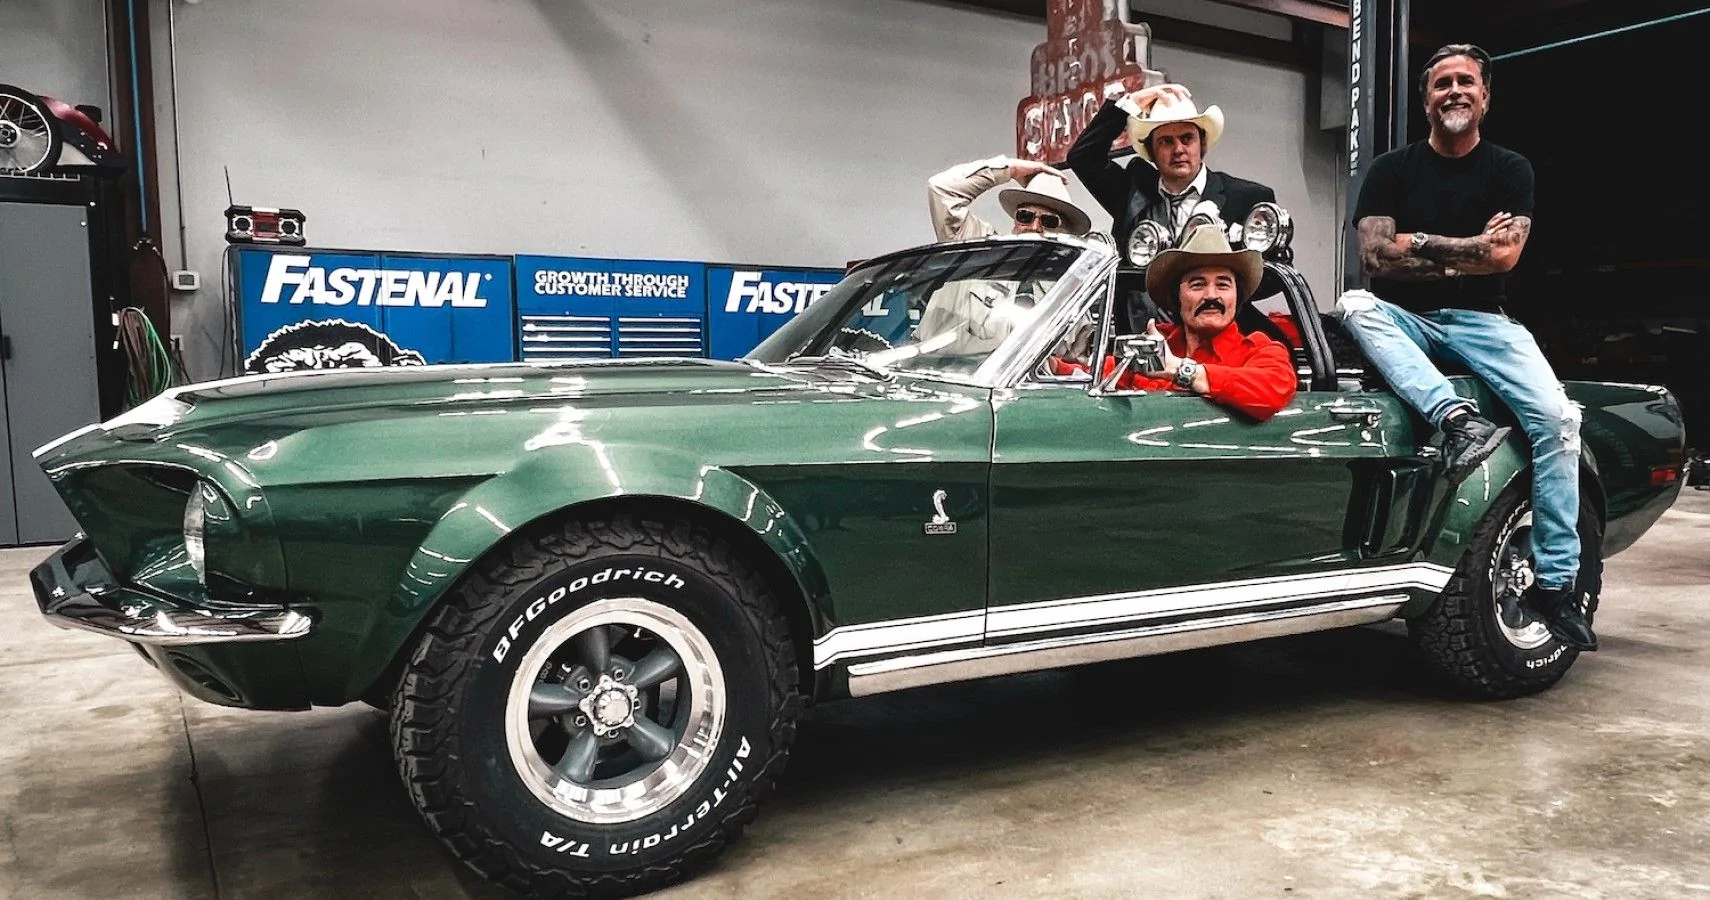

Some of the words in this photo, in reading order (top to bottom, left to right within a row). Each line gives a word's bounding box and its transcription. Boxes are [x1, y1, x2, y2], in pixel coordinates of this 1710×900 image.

[261, 254, 488, 307] FASTENAL
[534, 270, 609, 285] GROWTH
[612, 272, 689, 288] THROUGH
[534, 282, 622, 297] CUSTOMER
[624, 284, 687, 298] SERVICE
[492, 566, 686, 664] BFGoodrich
[608, 735, 752, 855] All-Terrain
[539, 830, 591, 858] T/A
